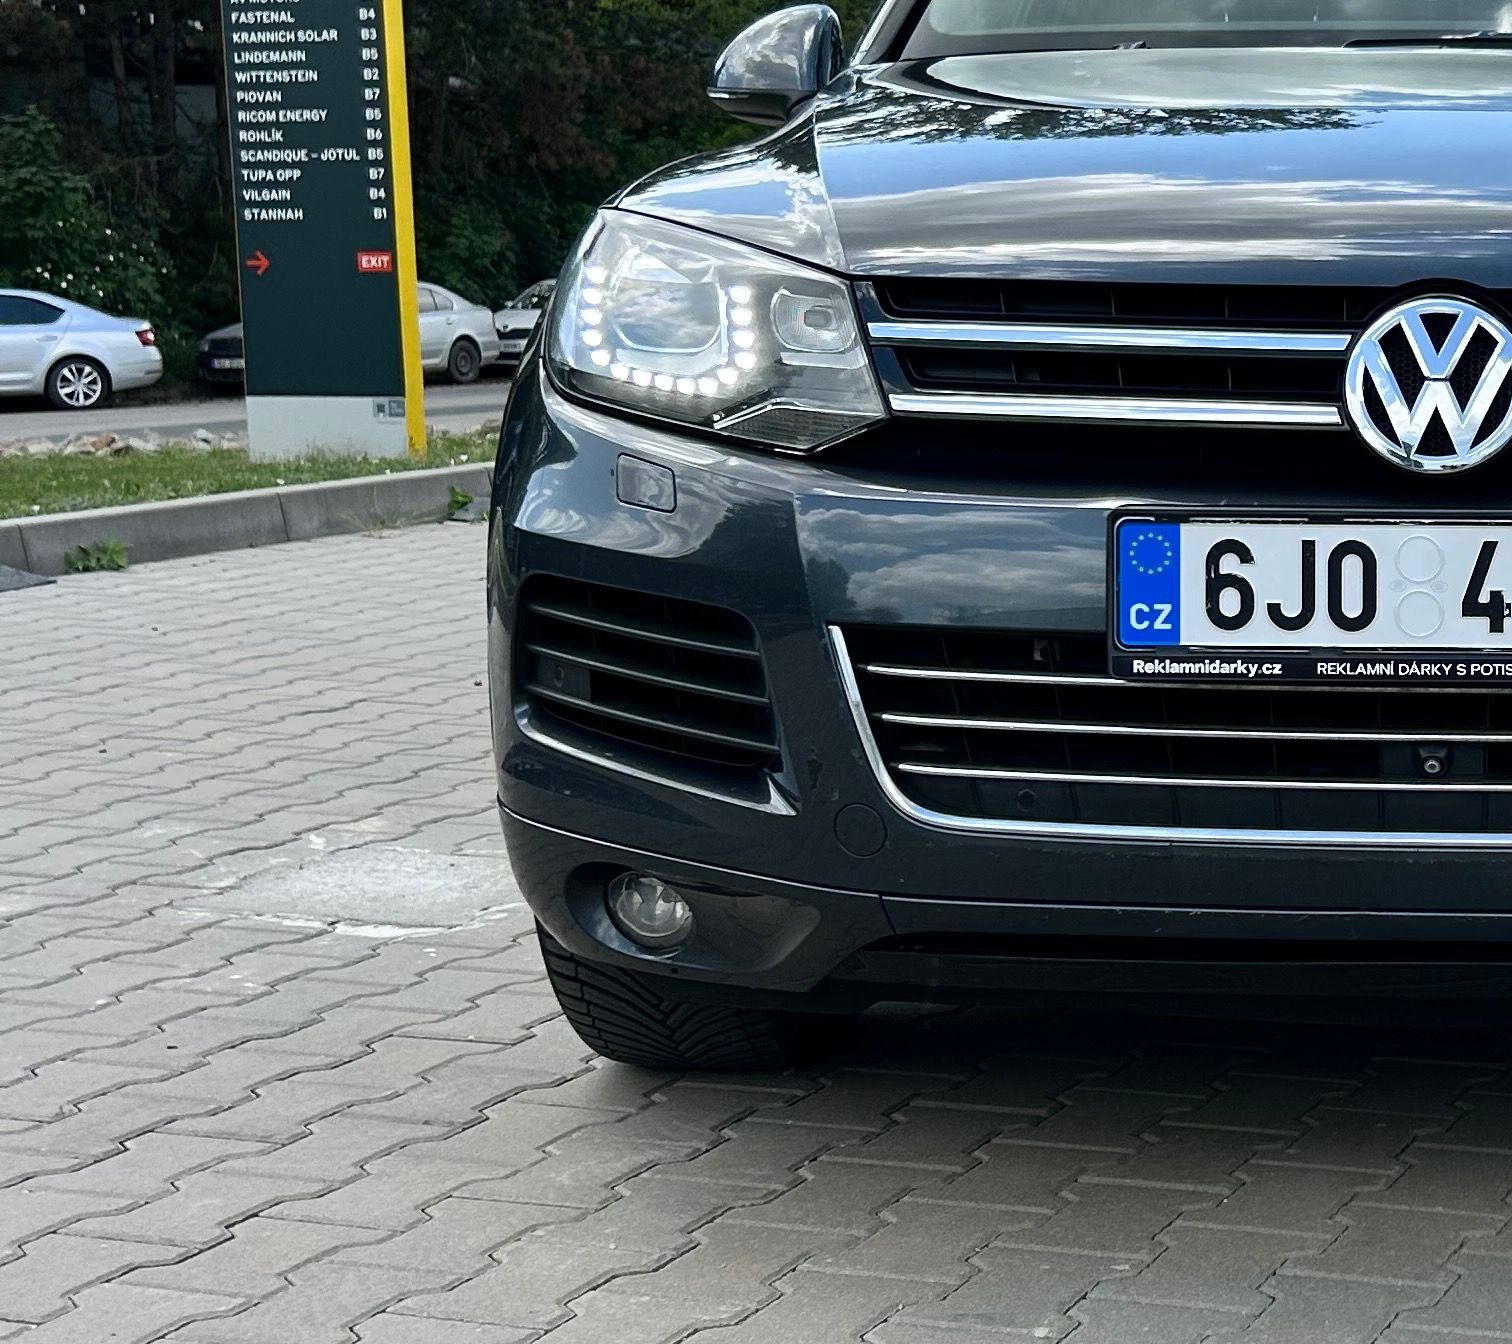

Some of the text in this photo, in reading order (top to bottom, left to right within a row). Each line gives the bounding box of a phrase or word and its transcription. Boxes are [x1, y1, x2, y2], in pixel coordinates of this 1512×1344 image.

[231, 8, 376, 24] FASTENAL B4
[232, 28, 378, 44] KRANNICH SOLAR B3
[234, 50, 306, 64] LINDEMANN
[234, 68, 380, 84] WITTENSTEIN B2
[236, 88, 380, 104] PIOVAN B7
[238, 110, 276, 123] RICOM
[278, 108, 328, 122] ENERGY
[239, 128, 284, 142] ROHLÍK
[240, 148, 309, 163] SCANDIQUE
[240, 167, 385, 182] TUPA OPP B7
[242, 188, 386, 202] VILGAIN B4
[244, 207, 388, 221] STANNAH B1
[362, 256, 390, 268] EXIT
[1204, 538, 1379, 633] 6J0
[1130, 602, 1172, 631] CZ
[1132, 660, 1282, 677] Reklamnidarky.cz
[1316, 660, 1395, 676] REKLAMNÍ
[1398, 660, 1452, 676] DÁRKY
[1456, 663, 1466, 676] S
